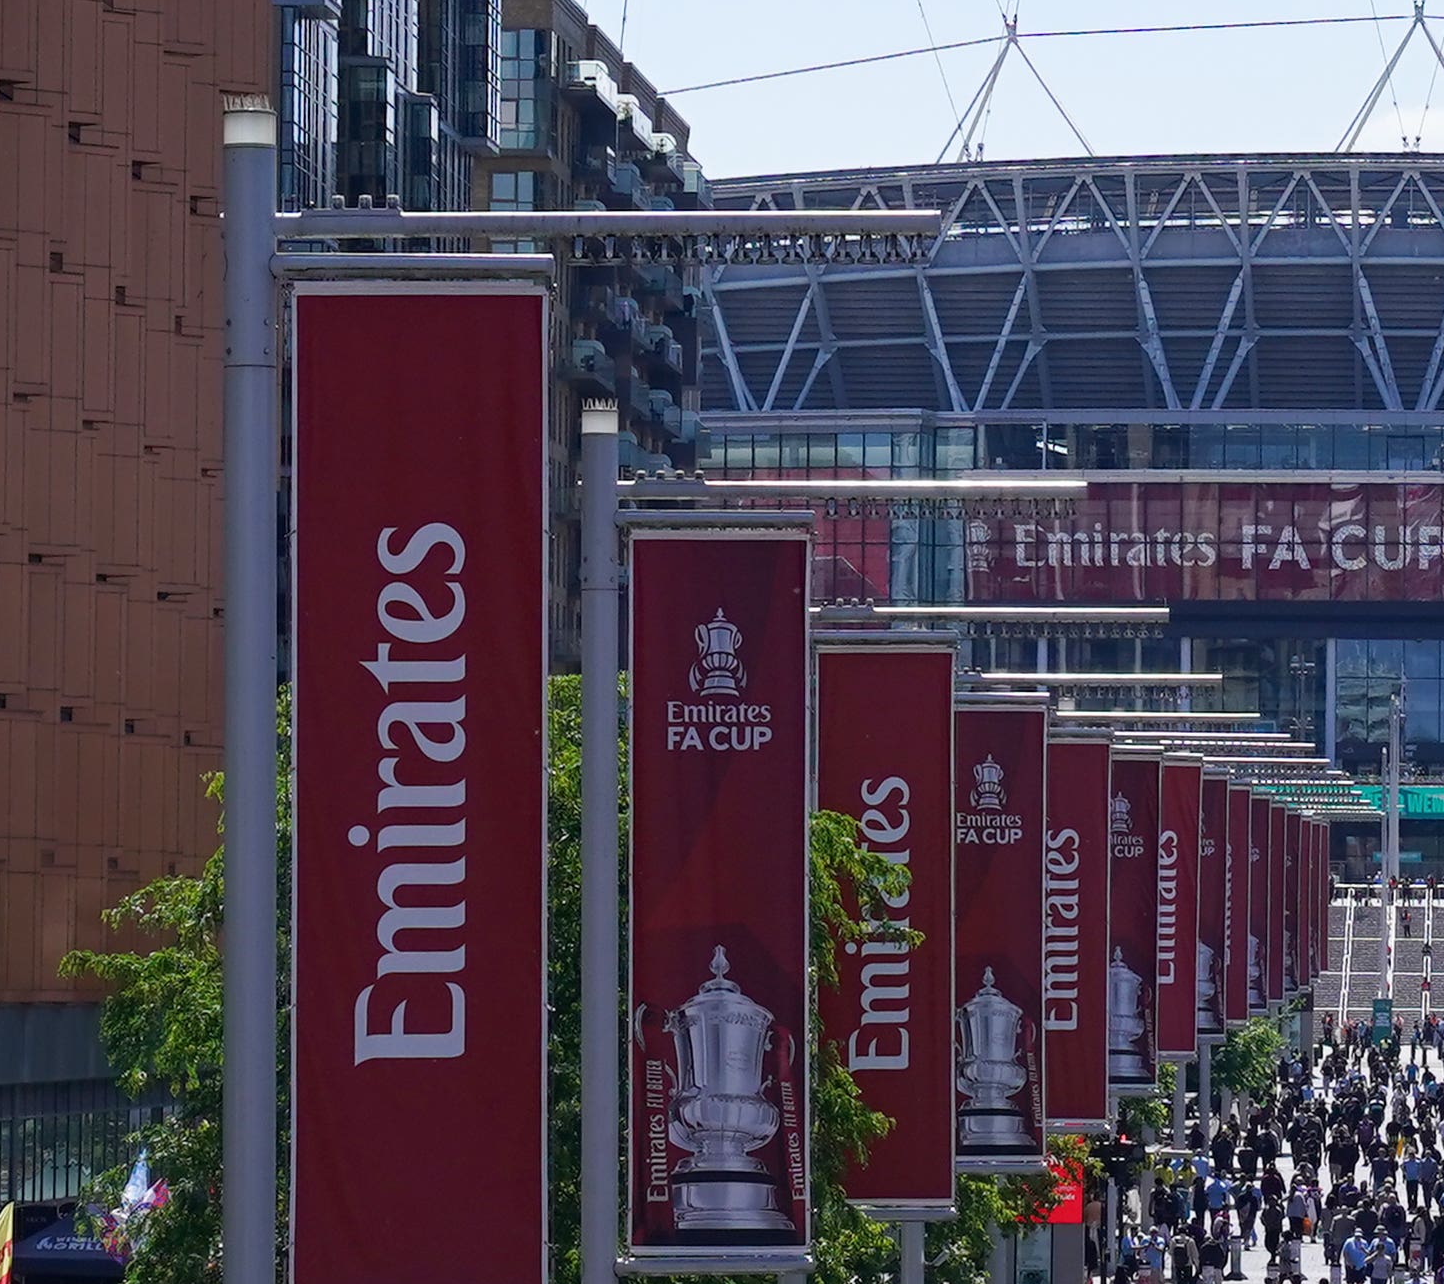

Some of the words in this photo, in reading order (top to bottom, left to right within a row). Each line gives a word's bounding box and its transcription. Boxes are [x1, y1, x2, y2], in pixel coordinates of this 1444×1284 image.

[1012, 523, 1216, 569] Emirates
[1241, 524, 1310, 570] FA
[666, 700, 772, 724] Emirates
[667, 727, 705, 751] FA
[709, 726, 773, 752] CUP
[348, 521, 467, 1066] Emirates
[957, 812, 1023, 827] Emirates
[957, 829, 980, 845] FA
[982, 828, 1023, 845] CUP
[1114, 846, 1144, 858] CUP
[1044, 828, 1080, 1031] Emirates
[646, 1114, 669, 1203] Emirates
[787, 1132, 807, 1201] Emirates
